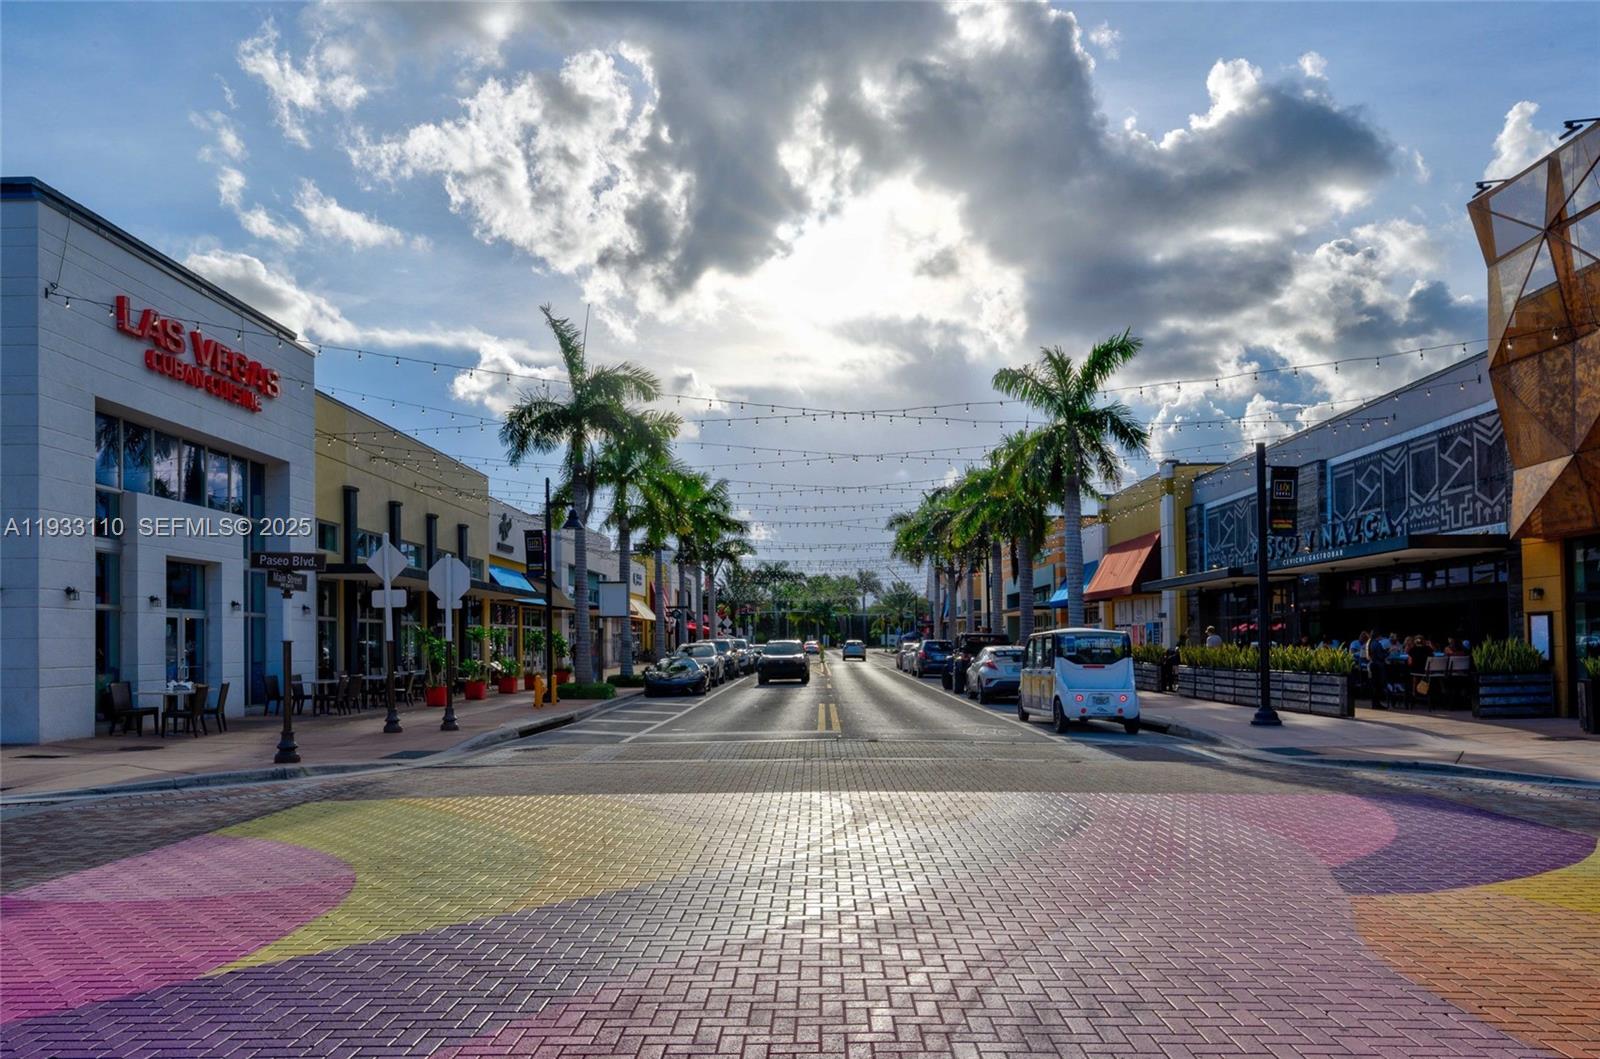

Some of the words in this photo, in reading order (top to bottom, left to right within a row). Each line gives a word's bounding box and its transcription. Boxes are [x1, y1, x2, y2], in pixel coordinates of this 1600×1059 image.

[116, 295, 186, 353] LAS
[190, 331, 281, 399] VEGAS
[144, 350, 205, 390] CUBAN
[204, 375, 263, 413] CUISINE
[1320, 511, 1392, 549] NAZCA
[259, 554, 289, 566] Paseo
[292, 555, 317, 567] Blvd.
[273, 572, 287, 582] Main
[287, 573, 303, 585] Street
